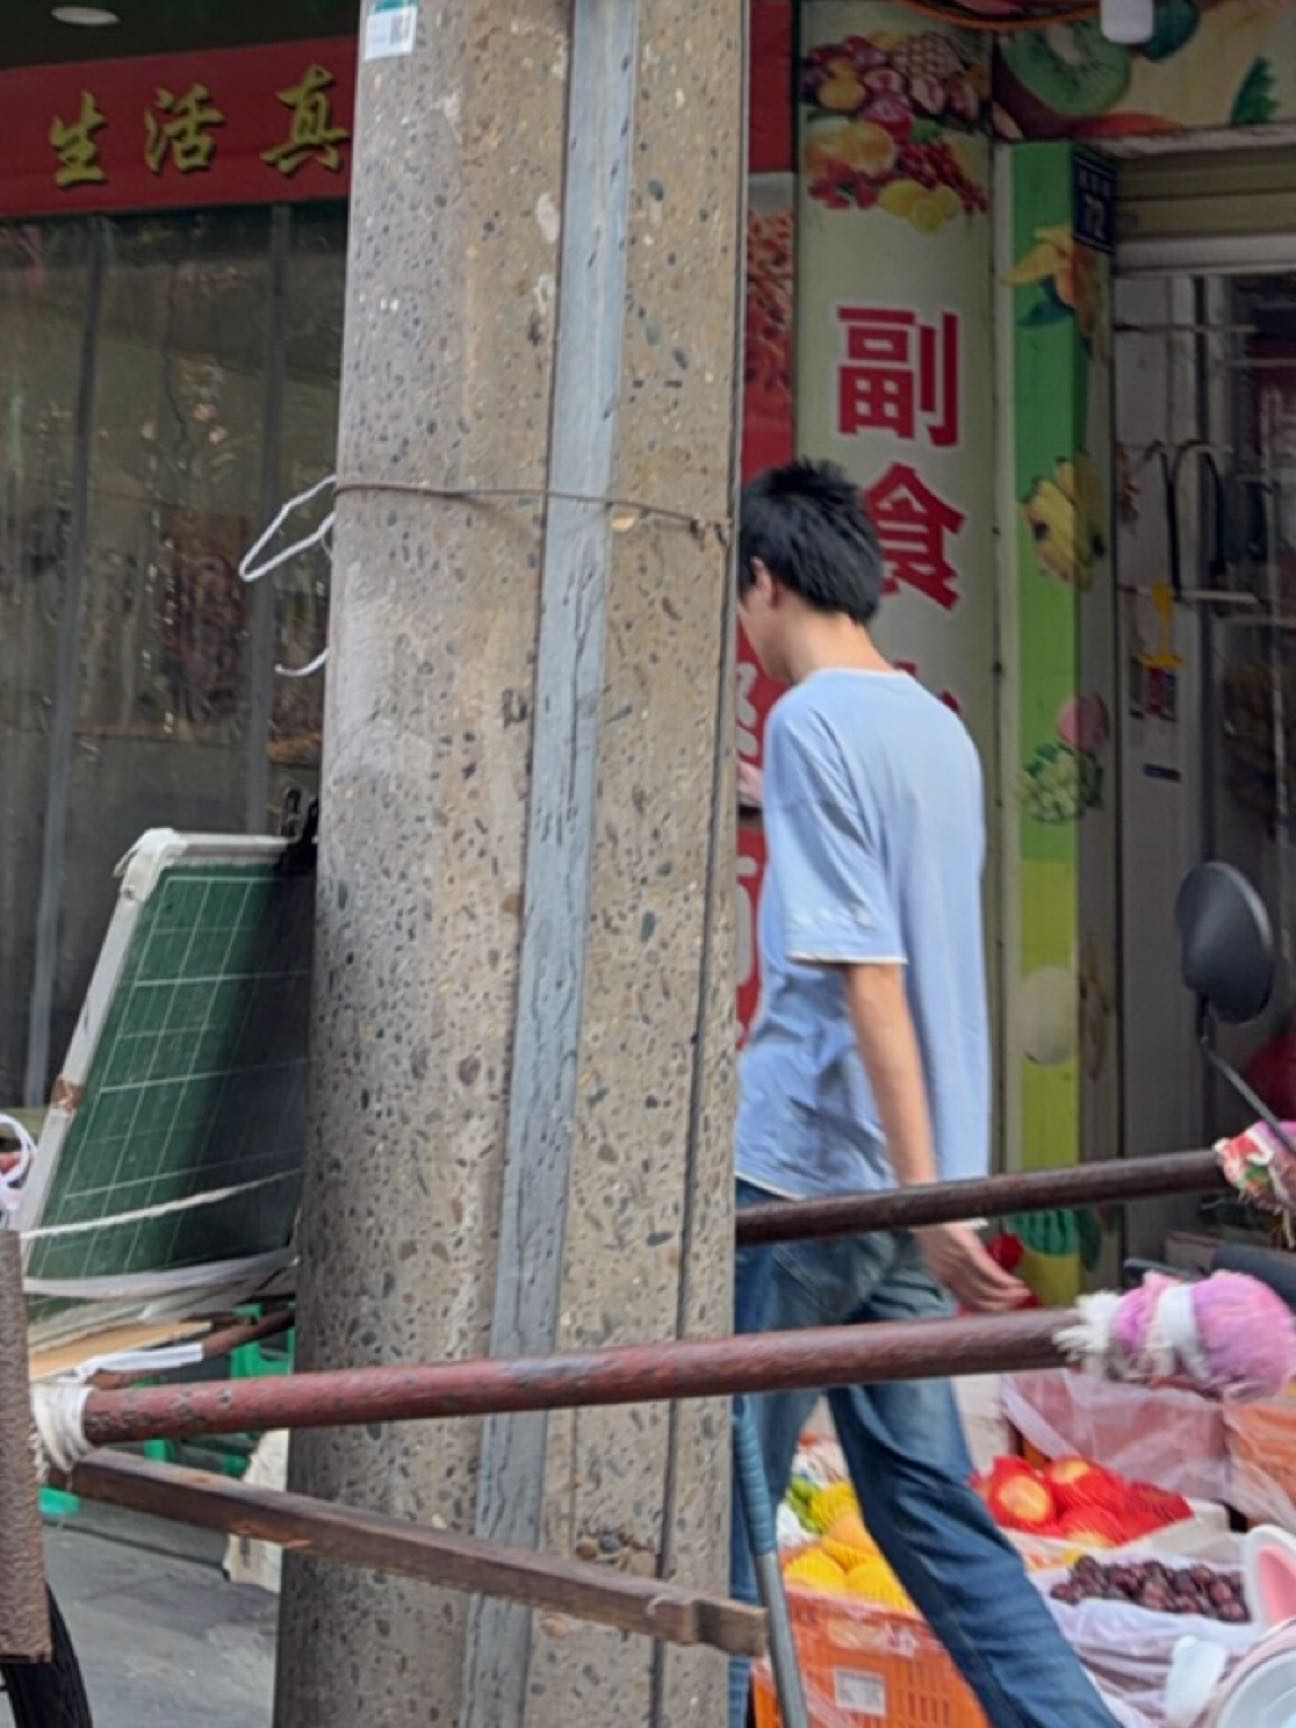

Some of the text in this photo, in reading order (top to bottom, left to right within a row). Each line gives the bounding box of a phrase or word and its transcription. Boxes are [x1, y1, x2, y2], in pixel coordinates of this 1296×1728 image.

[49, 65, 350, 190] 生活真
[837, 305, 967, 714] 副食
